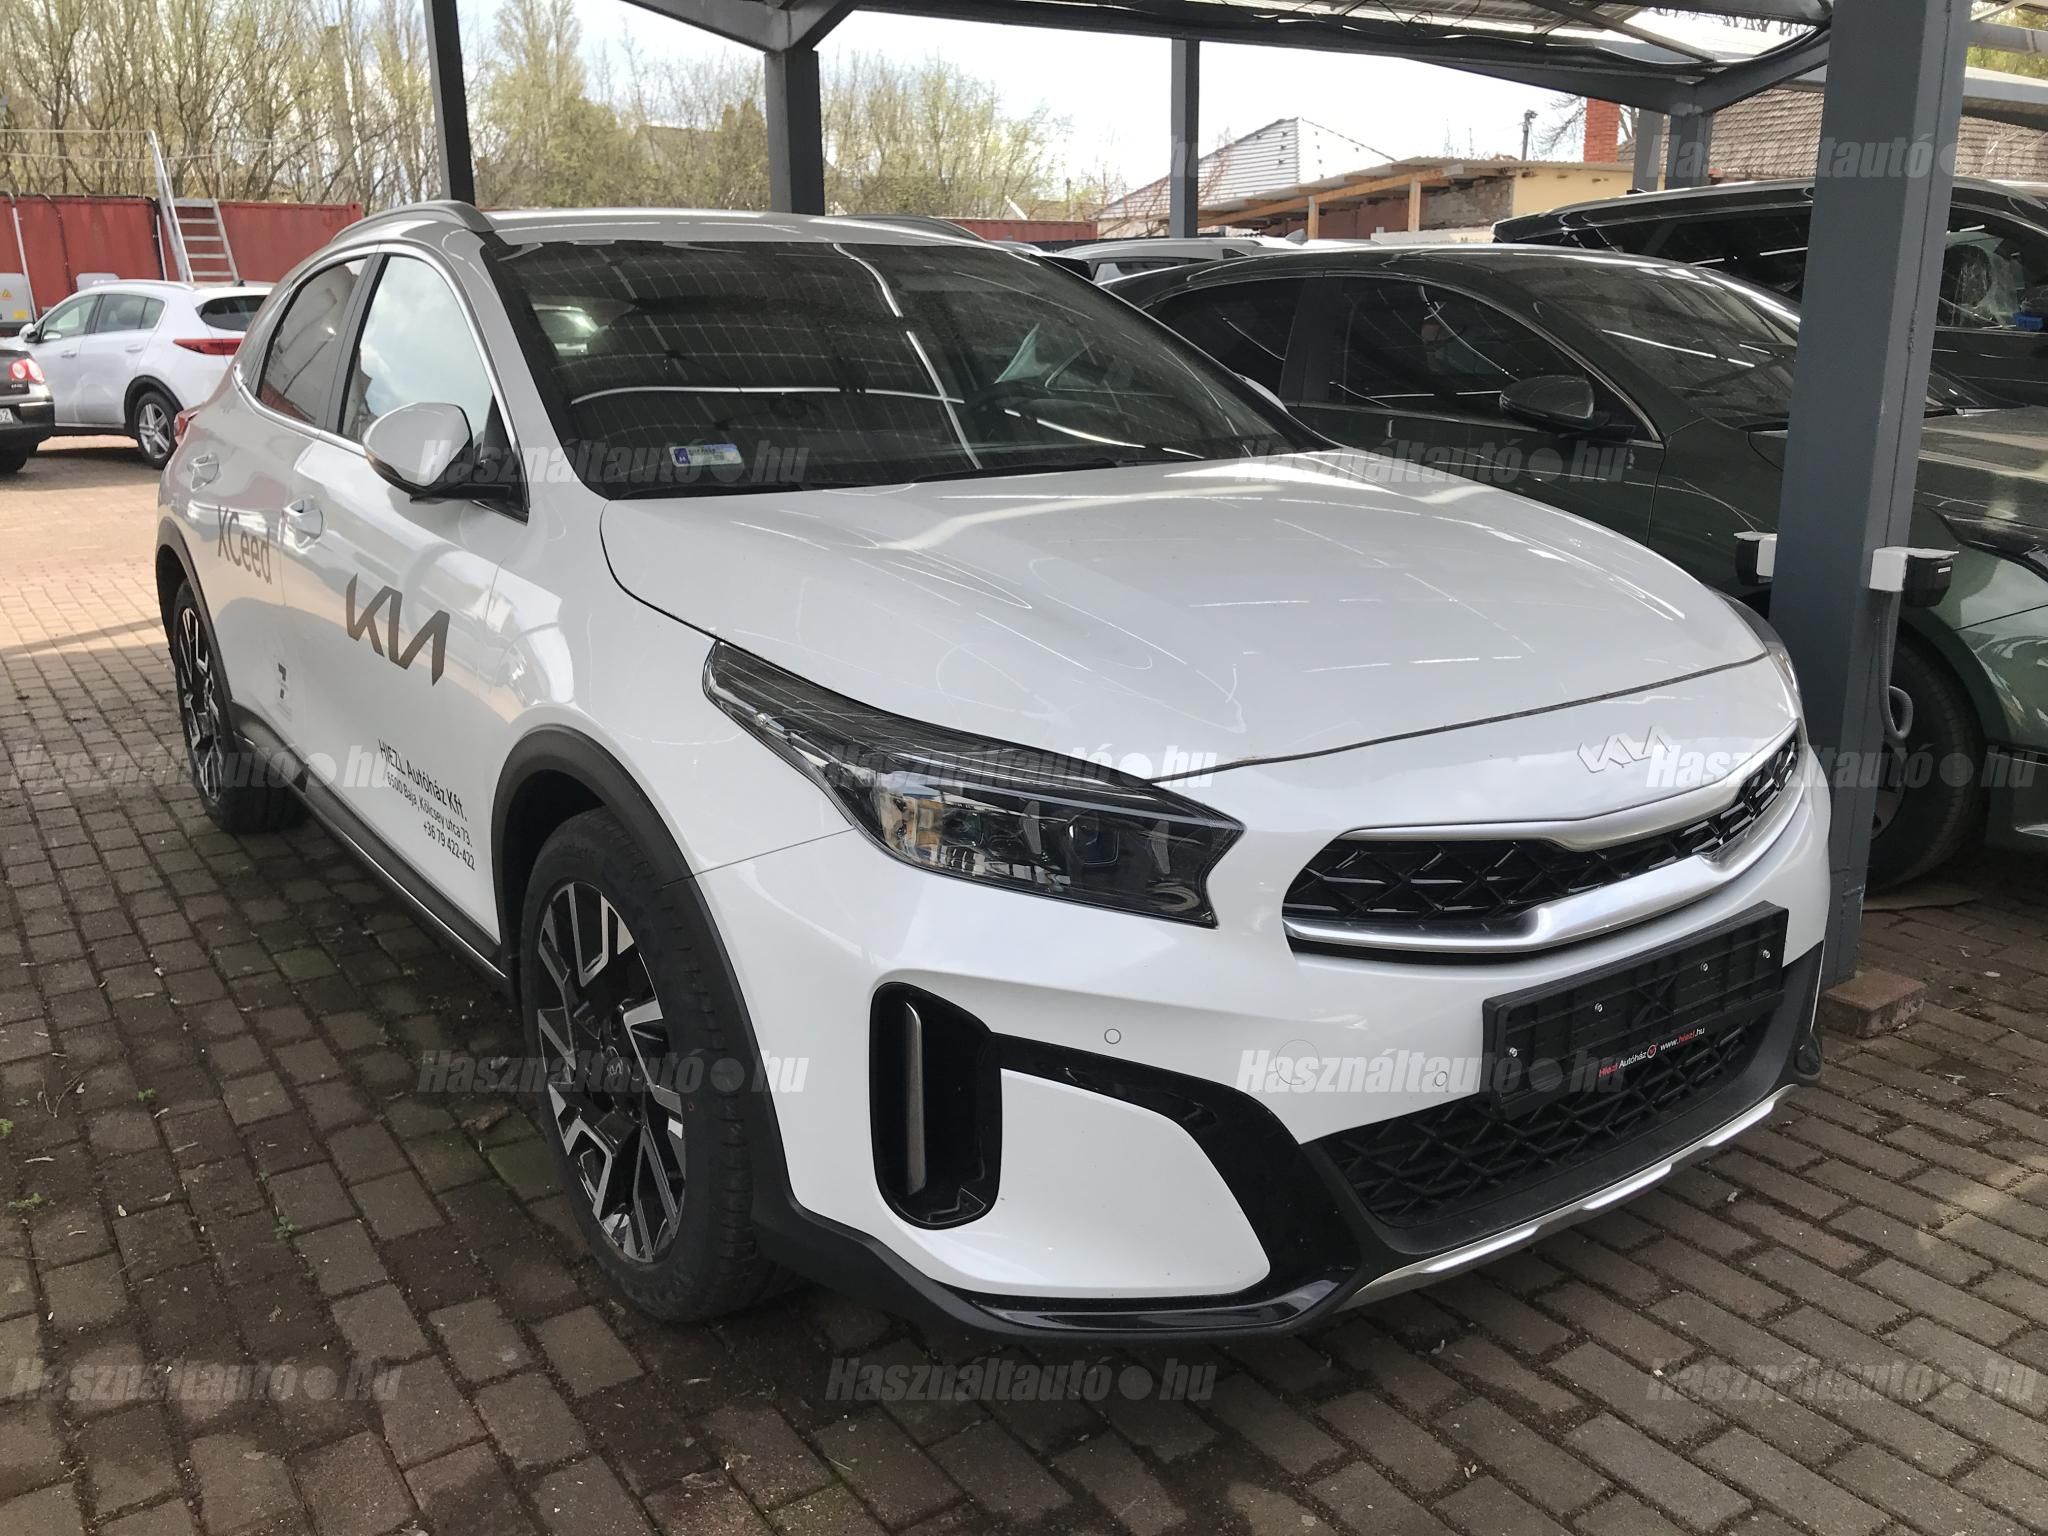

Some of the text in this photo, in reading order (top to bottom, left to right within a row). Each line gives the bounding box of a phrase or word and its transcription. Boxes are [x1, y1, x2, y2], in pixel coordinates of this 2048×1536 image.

[217, 505, 272, 584] XCeed
[406, 760, 447, 806] Autóház
[423, 821, 476, 872] +36 79 422-422
[445, 817, 461, 838] utca
[1618, 1051, 1648, 1069] Autóház
